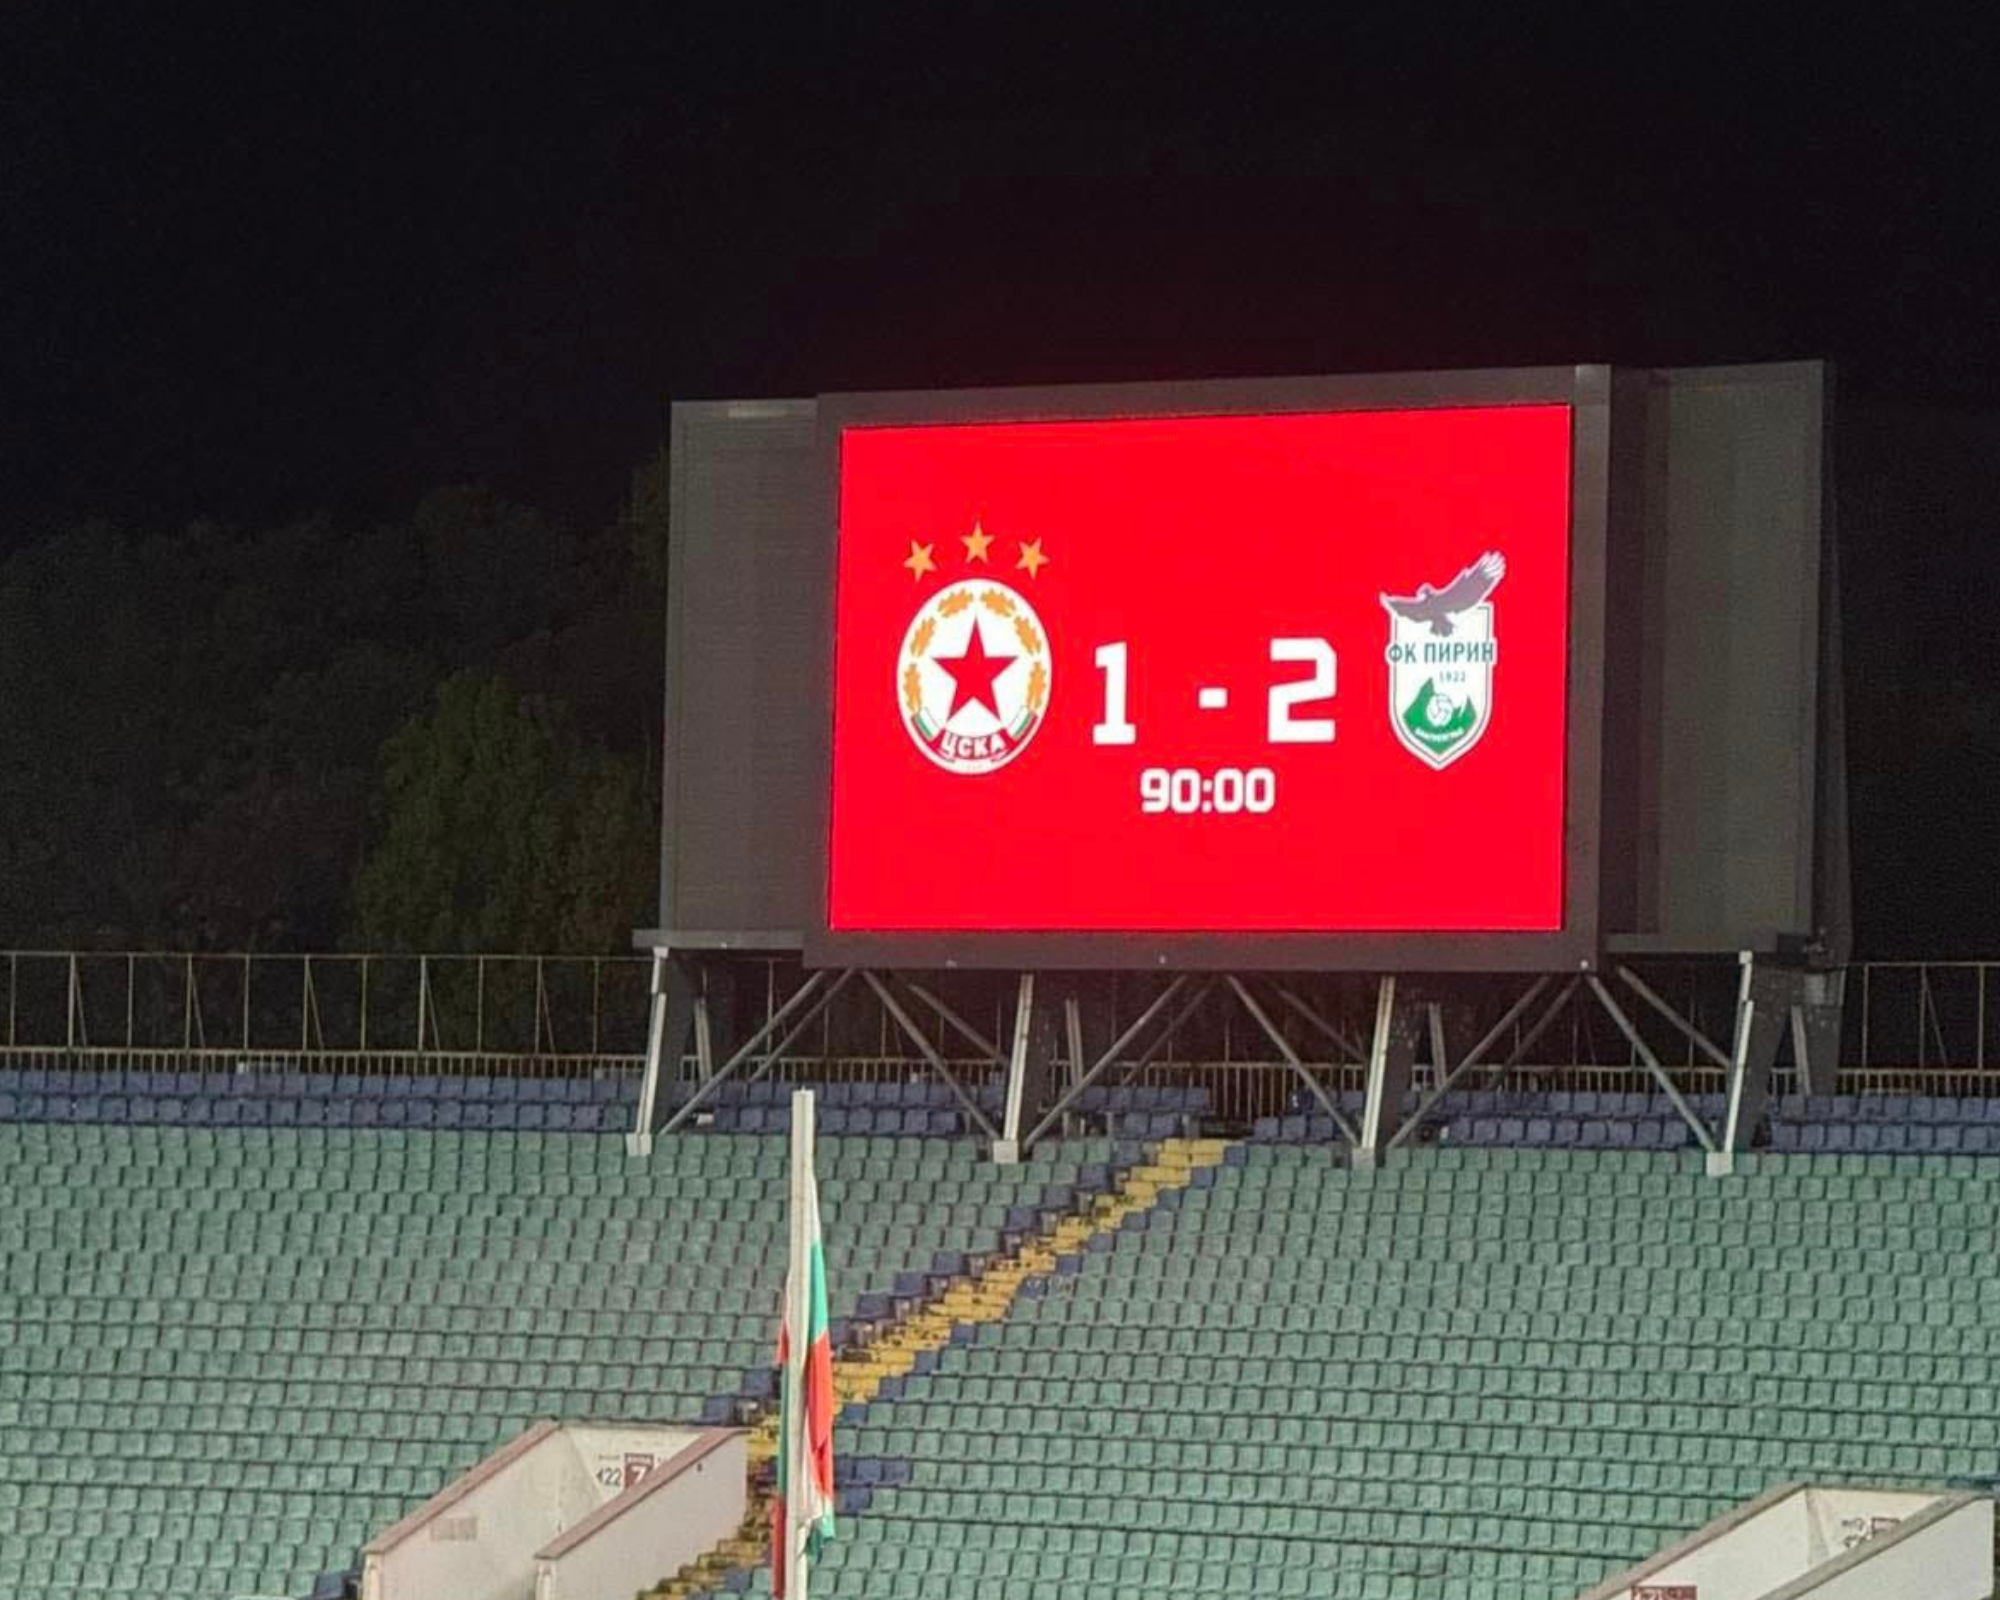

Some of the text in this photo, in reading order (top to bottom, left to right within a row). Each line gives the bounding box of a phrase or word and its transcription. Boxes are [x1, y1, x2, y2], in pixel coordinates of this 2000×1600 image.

[1389, 642, 1493, 664] ФК ПИРИН
[1093, 643, 1135, 744] 1
[1268, 638, 1336, 742] 2
[940, 731, 1008, 762] ЦСКА
[1141, 768, 1274, 812] 90:00
